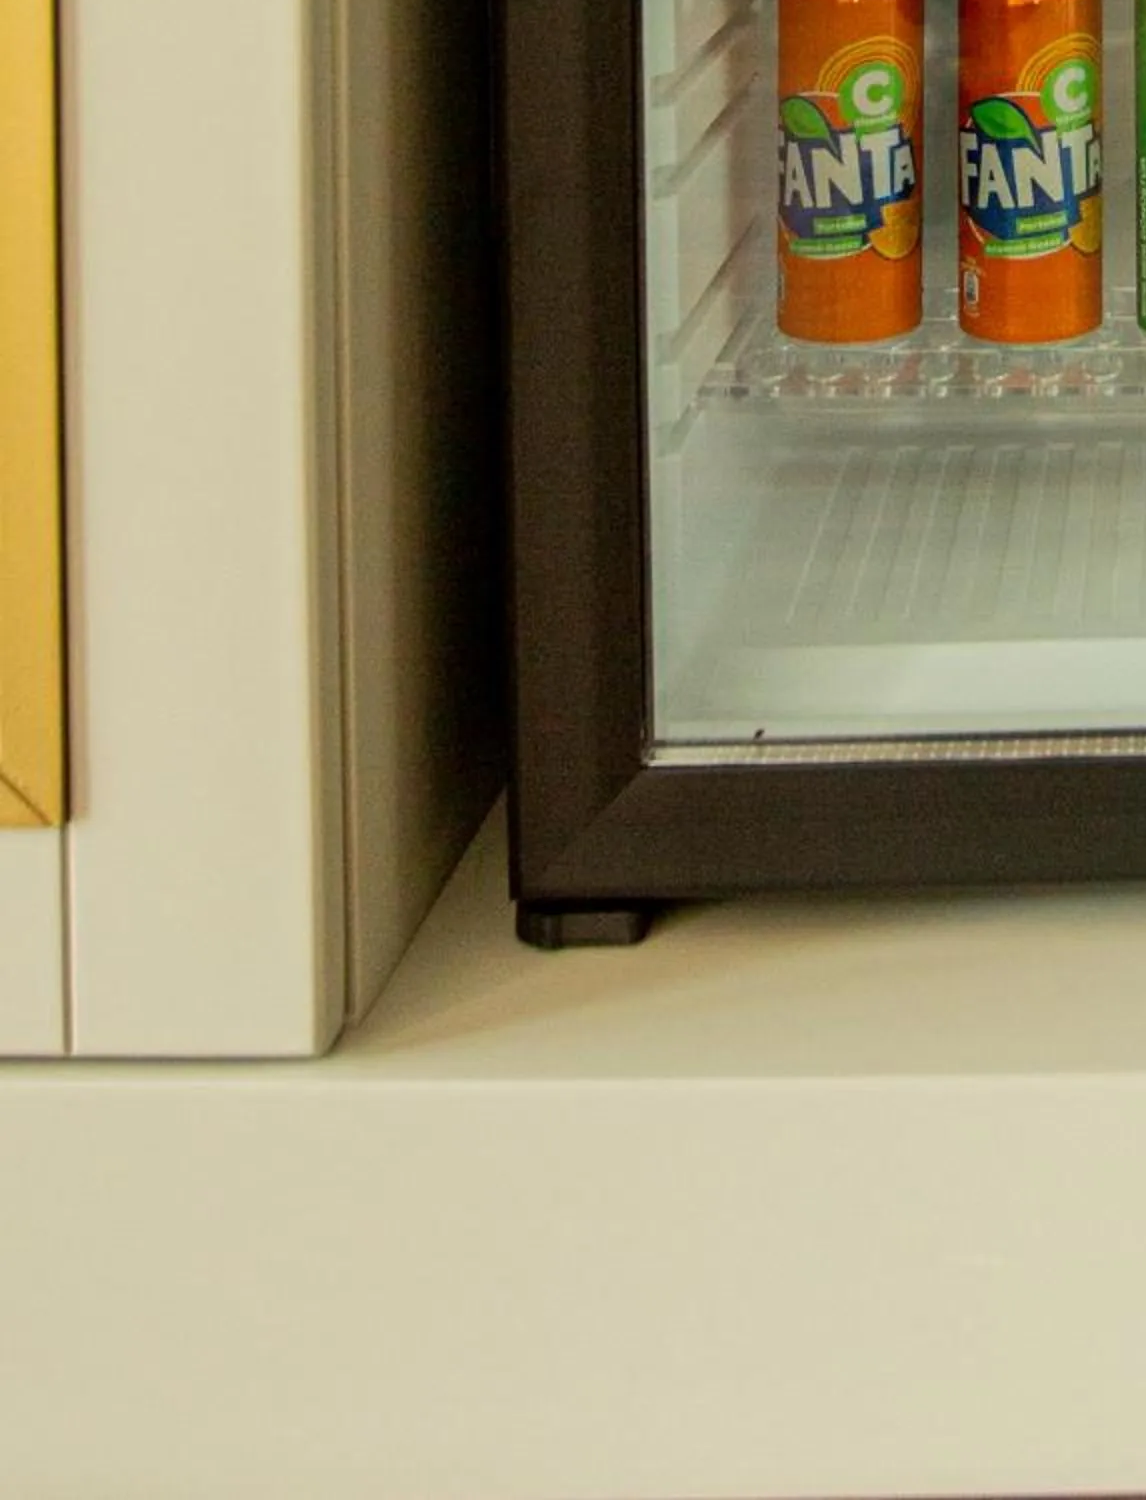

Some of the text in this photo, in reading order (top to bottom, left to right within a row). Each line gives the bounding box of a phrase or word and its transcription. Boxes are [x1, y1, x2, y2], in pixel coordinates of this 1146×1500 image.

[852, 70, 894, 116] C
[1053, 67, 1088, 113] C
[778, 127, 916, 209] ANTA
